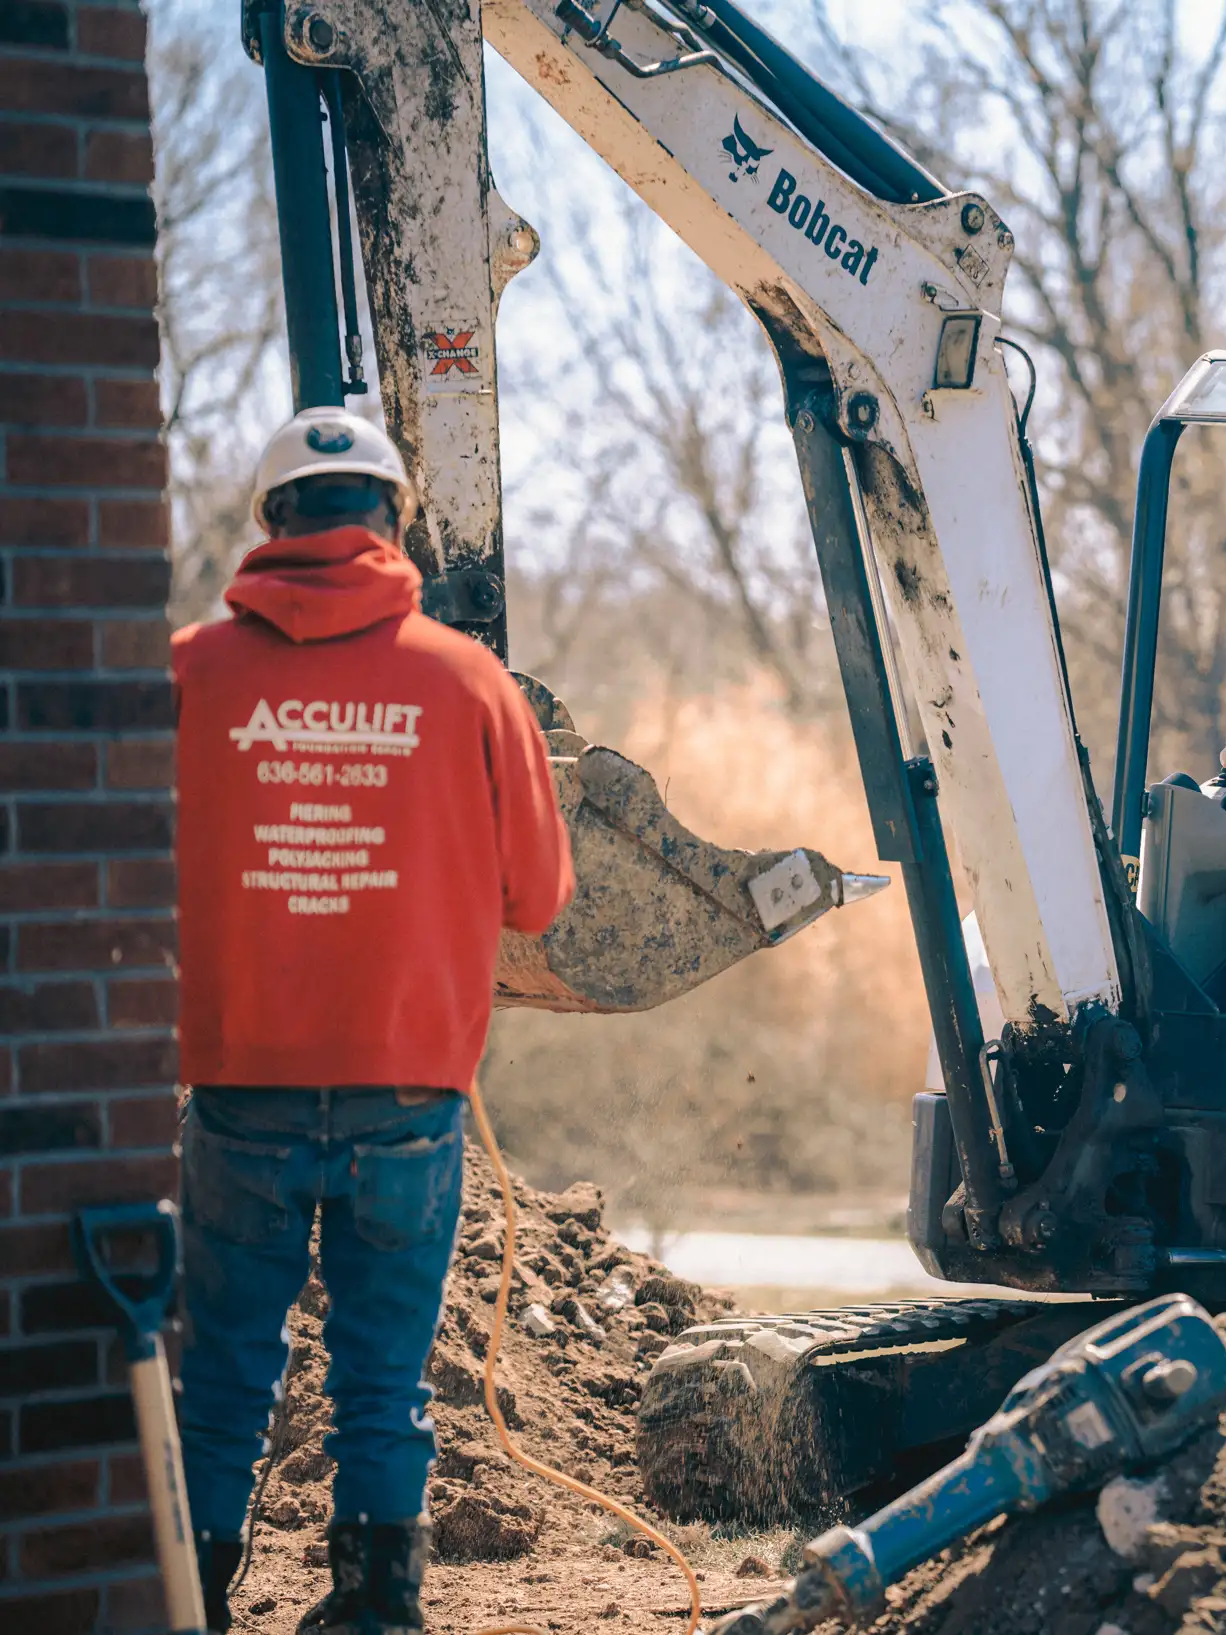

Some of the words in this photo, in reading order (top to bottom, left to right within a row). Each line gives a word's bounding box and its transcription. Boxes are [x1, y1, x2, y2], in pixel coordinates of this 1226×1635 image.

[766, 167, 879, 287] Bobcat
[427, 348, 478, 360] X-CHANGE
[229, 698, 423, 752] ACCULIFT
[289, 802, 352, 823] PIERING
[253, 823, 386, 845] WATERPROOFING
[241, 870, 340, 892] STRUCTURAL
[340, 869, 399, 890] REPAIR
